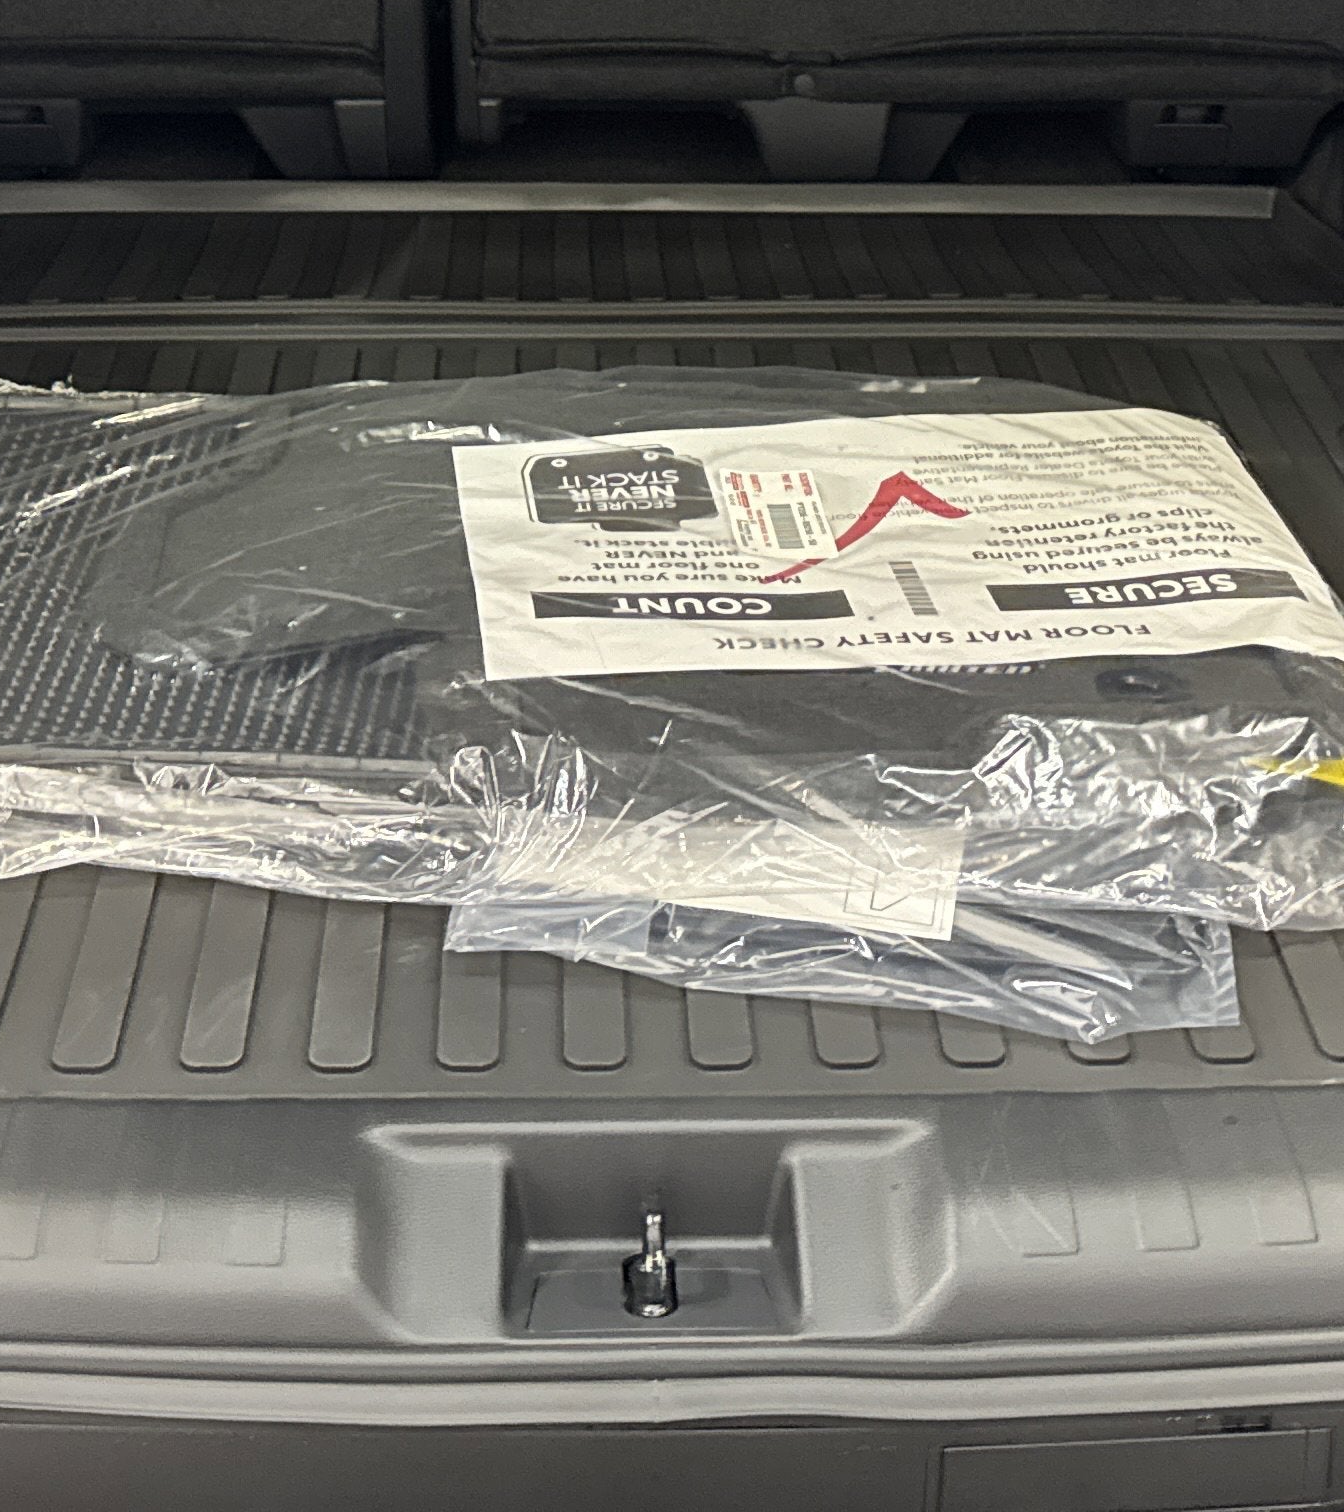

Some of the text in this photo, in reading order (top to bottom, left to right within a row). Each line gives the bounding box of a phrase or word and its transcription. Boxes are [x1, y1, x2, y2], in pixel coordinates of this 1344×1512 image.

[558, 469, 680, 489] STACK IT
[948, 475, 978, 485] Mat
[568, 484, 675, 502] NEVER
[977, 494, 995, 504] of
[574, 498, 677, 513] SECURE IT
[973, 502, 1034, 514] inspect
[1036, 502, 1055, 510] to
[990, 507, 1213, 535] clips or grommets.
[984, 521, 1236, 549] the factory retention
[573, 539, 599, 549] it.
[605, 539, 669, 549] stack
[972, 533, 1262, 562] always be secured using
[604, 550, 688, 559] NEVER
[590, 561, 760, 571] one floor mat
[1022, 548, 1232, 574] Floor mat should
[557, 574, 617, 585] have
[623, 571, 670, 583] you
[675, 573, 728, 582] sure
[1064, 573, 1238, 605] SECURE
[612, 597, 772, 615] COUNT
[712, 624, 1151, 651] FLOOR MAT SAFETY CHECK
